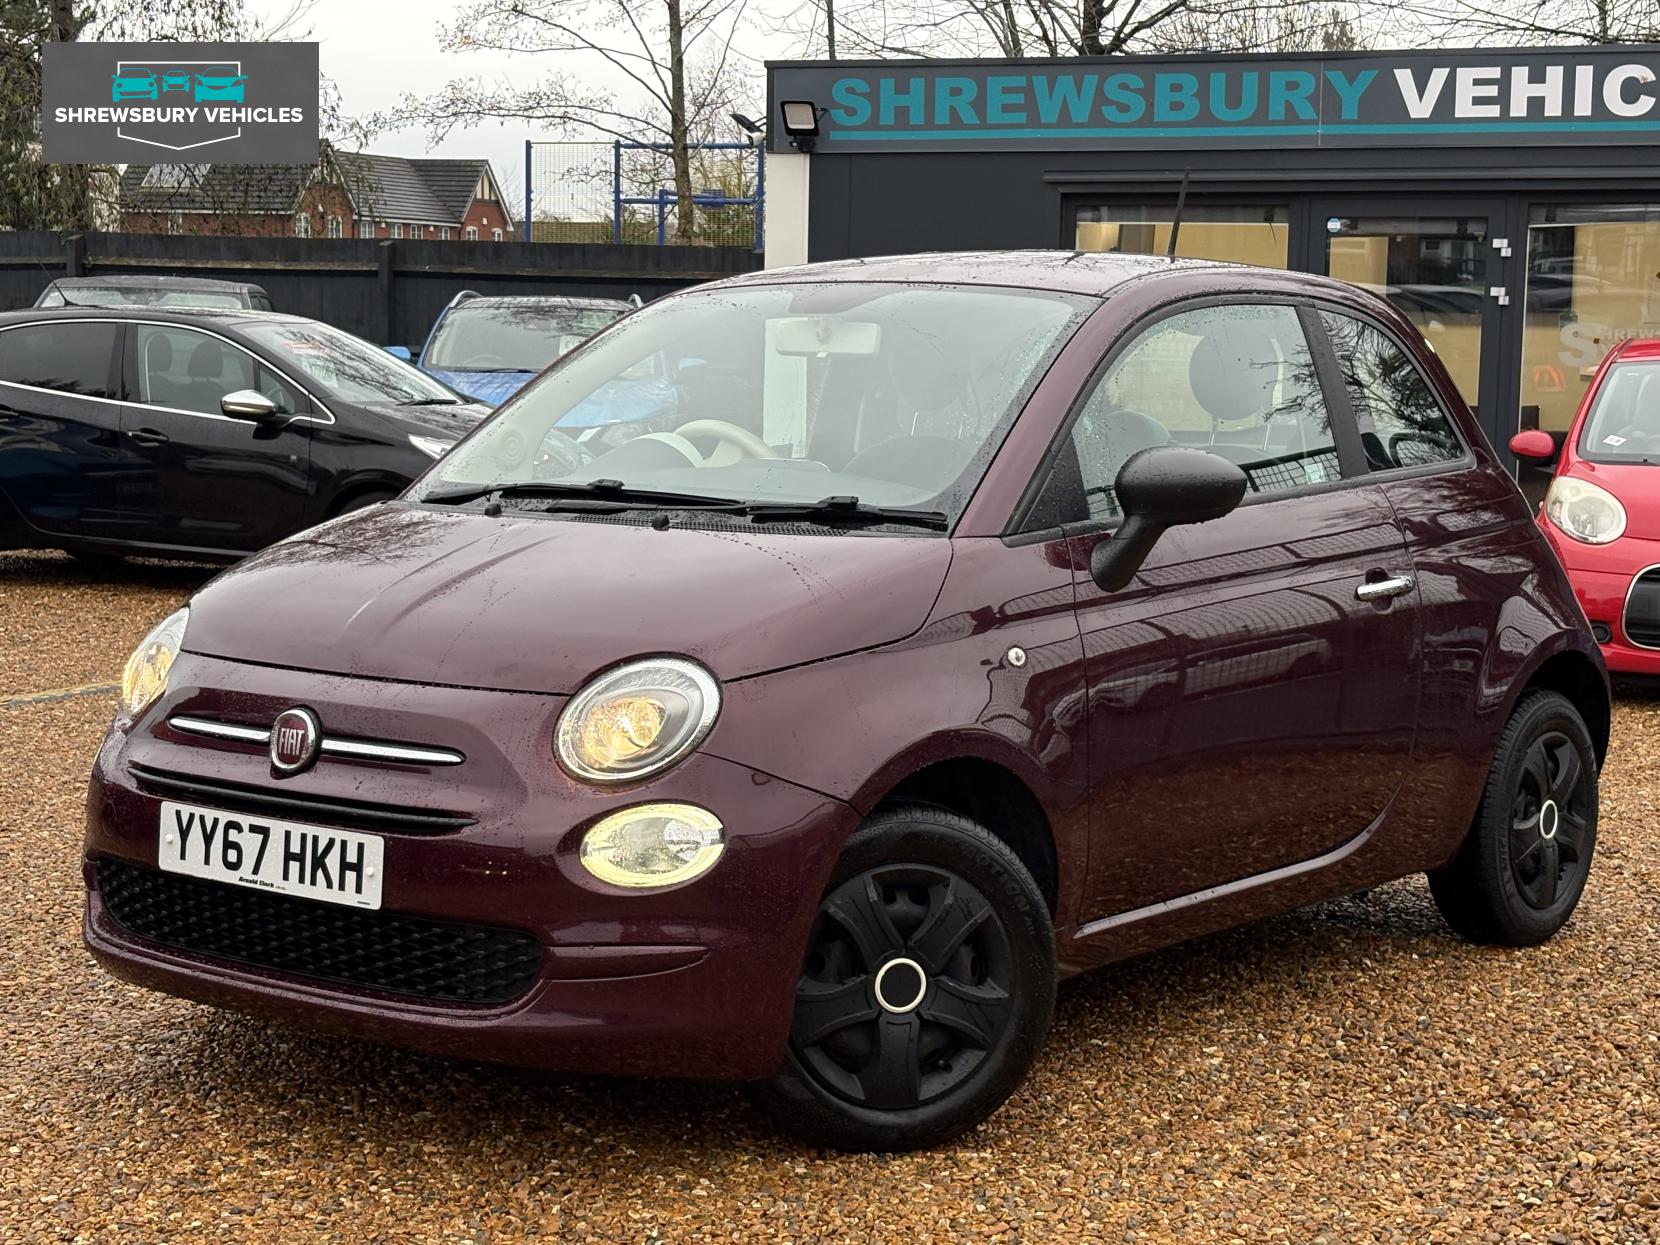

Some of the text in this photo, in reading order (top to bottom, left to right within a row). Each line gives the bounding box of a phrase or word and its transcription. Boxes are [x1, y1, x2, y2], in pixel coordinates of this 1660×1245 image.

[831, 64, 1658, 127] SHREWSBURY VEHIC
[278, 727, 305, 757] FIAT
[174, 808, 366, 895] YY67 HKH
